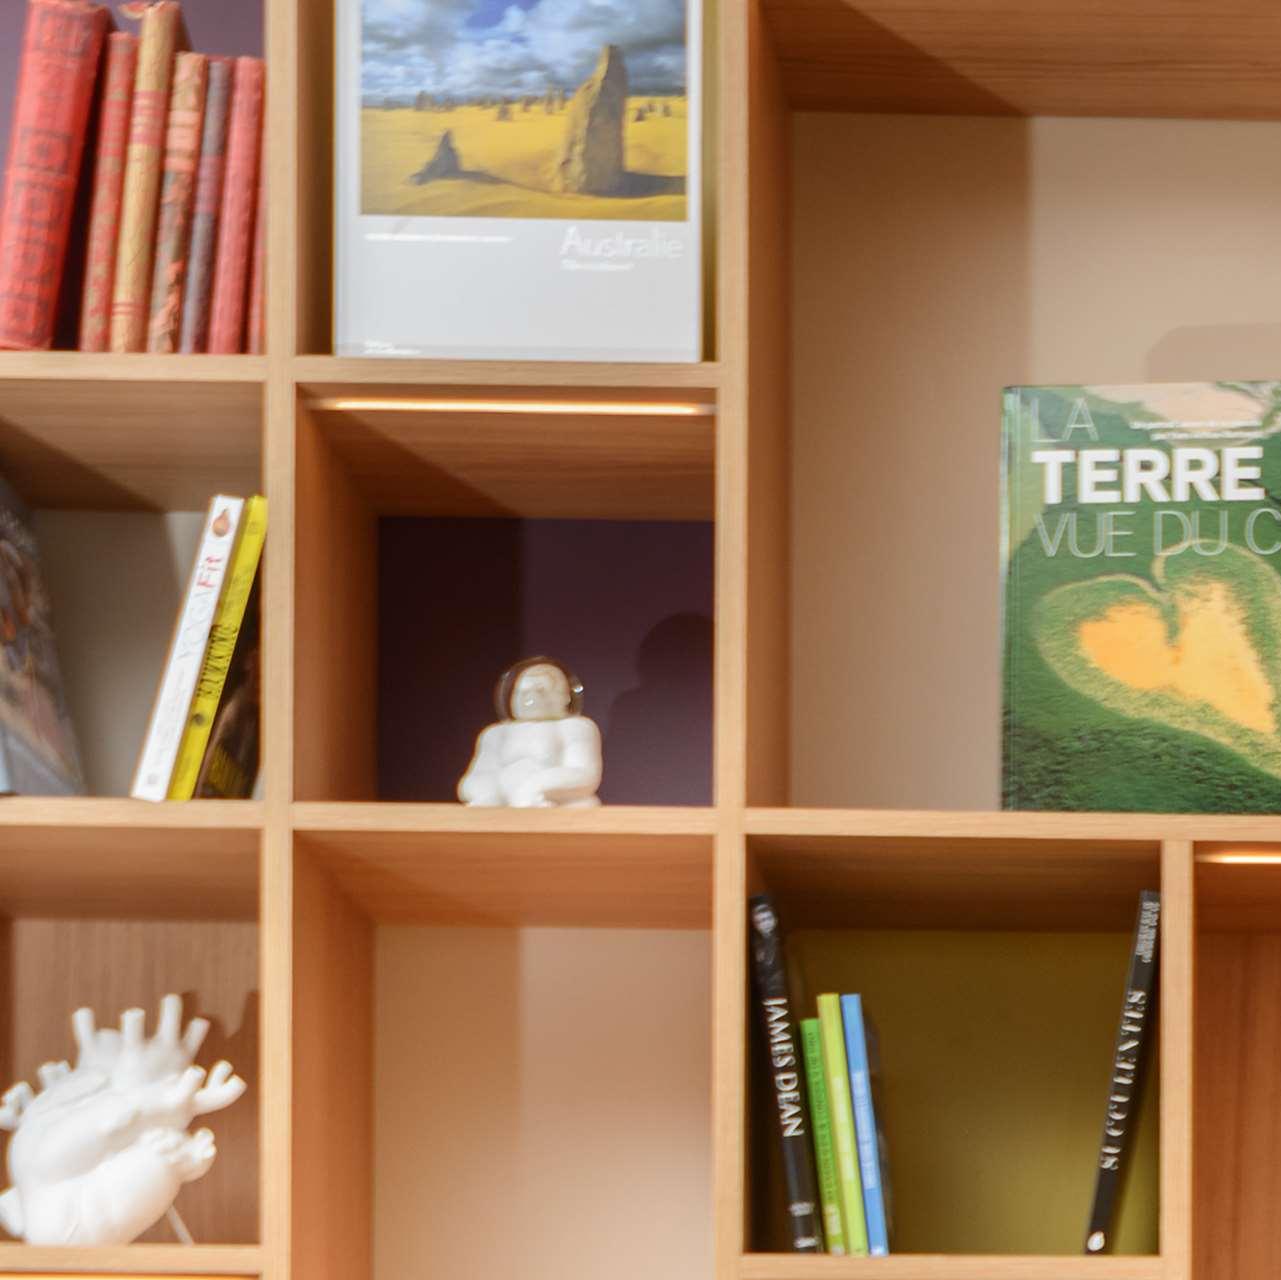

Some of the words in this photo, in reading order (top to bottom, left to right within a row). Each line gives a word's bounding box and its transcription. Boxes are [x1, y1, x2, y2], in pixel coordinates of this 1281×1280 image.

[559, 226, 685, 259] Australie
[1030, 397, 1099, 443] LA
[1031, 446, 1266, 505] TERRE
[1032, 510, 1138, 559] VUE
[1154, 510, 1230, 557] DU
[763, 997, 796, 1069] JAMES
[774, 1070, 804, 1138] DEAN
